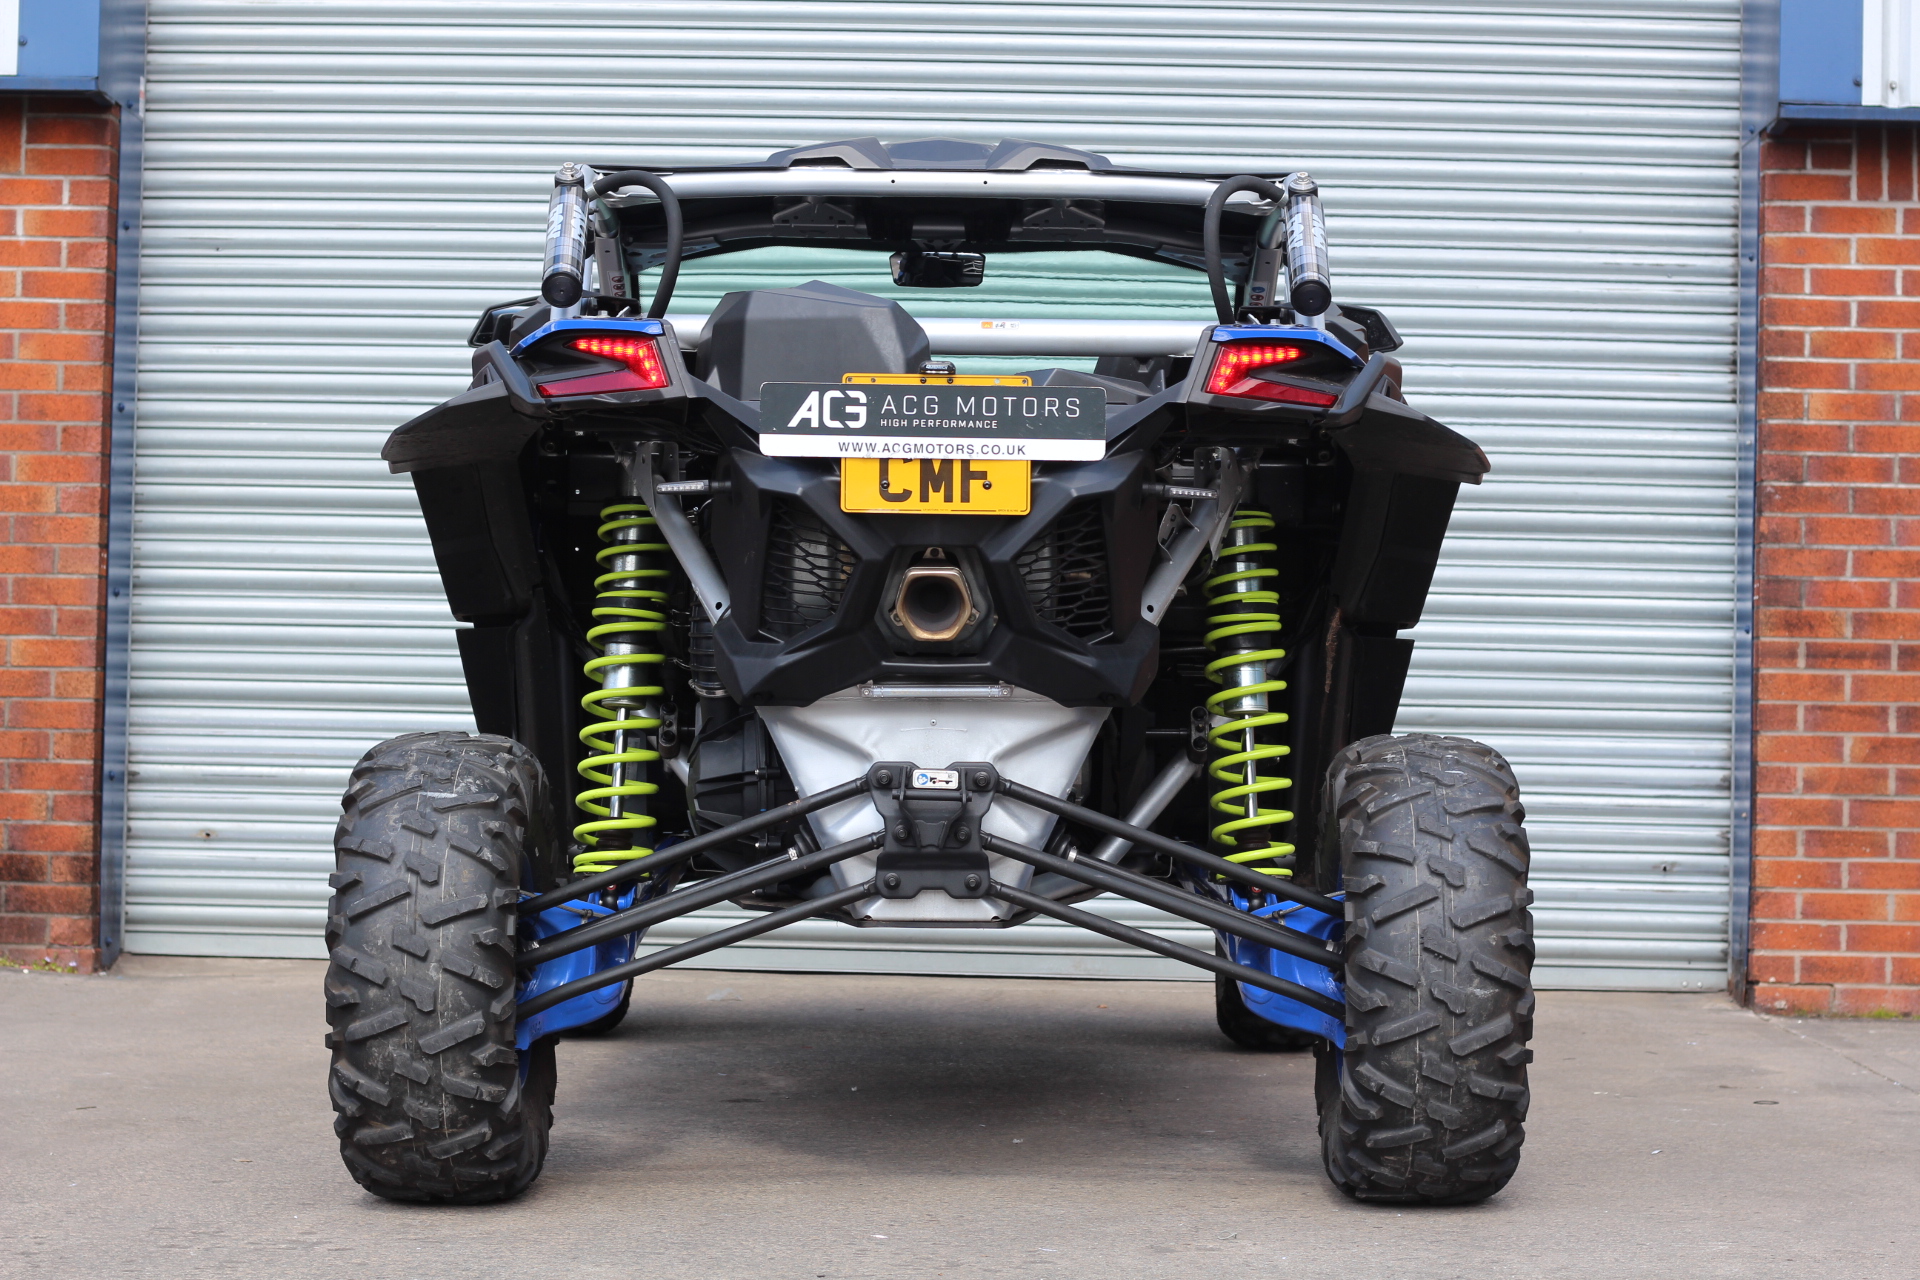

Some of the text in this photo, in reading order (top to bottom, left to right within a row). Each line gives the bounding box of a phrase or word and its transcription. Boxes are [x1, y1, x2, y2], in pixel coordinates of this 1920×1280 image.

[881, 395, 1080, 418] ACG MOTORS
[880, 419, 998, 429] HIGH PERFORMANCE
[838, 441, 1026, 455] WWW.ACGMOTORS.CO.UK
